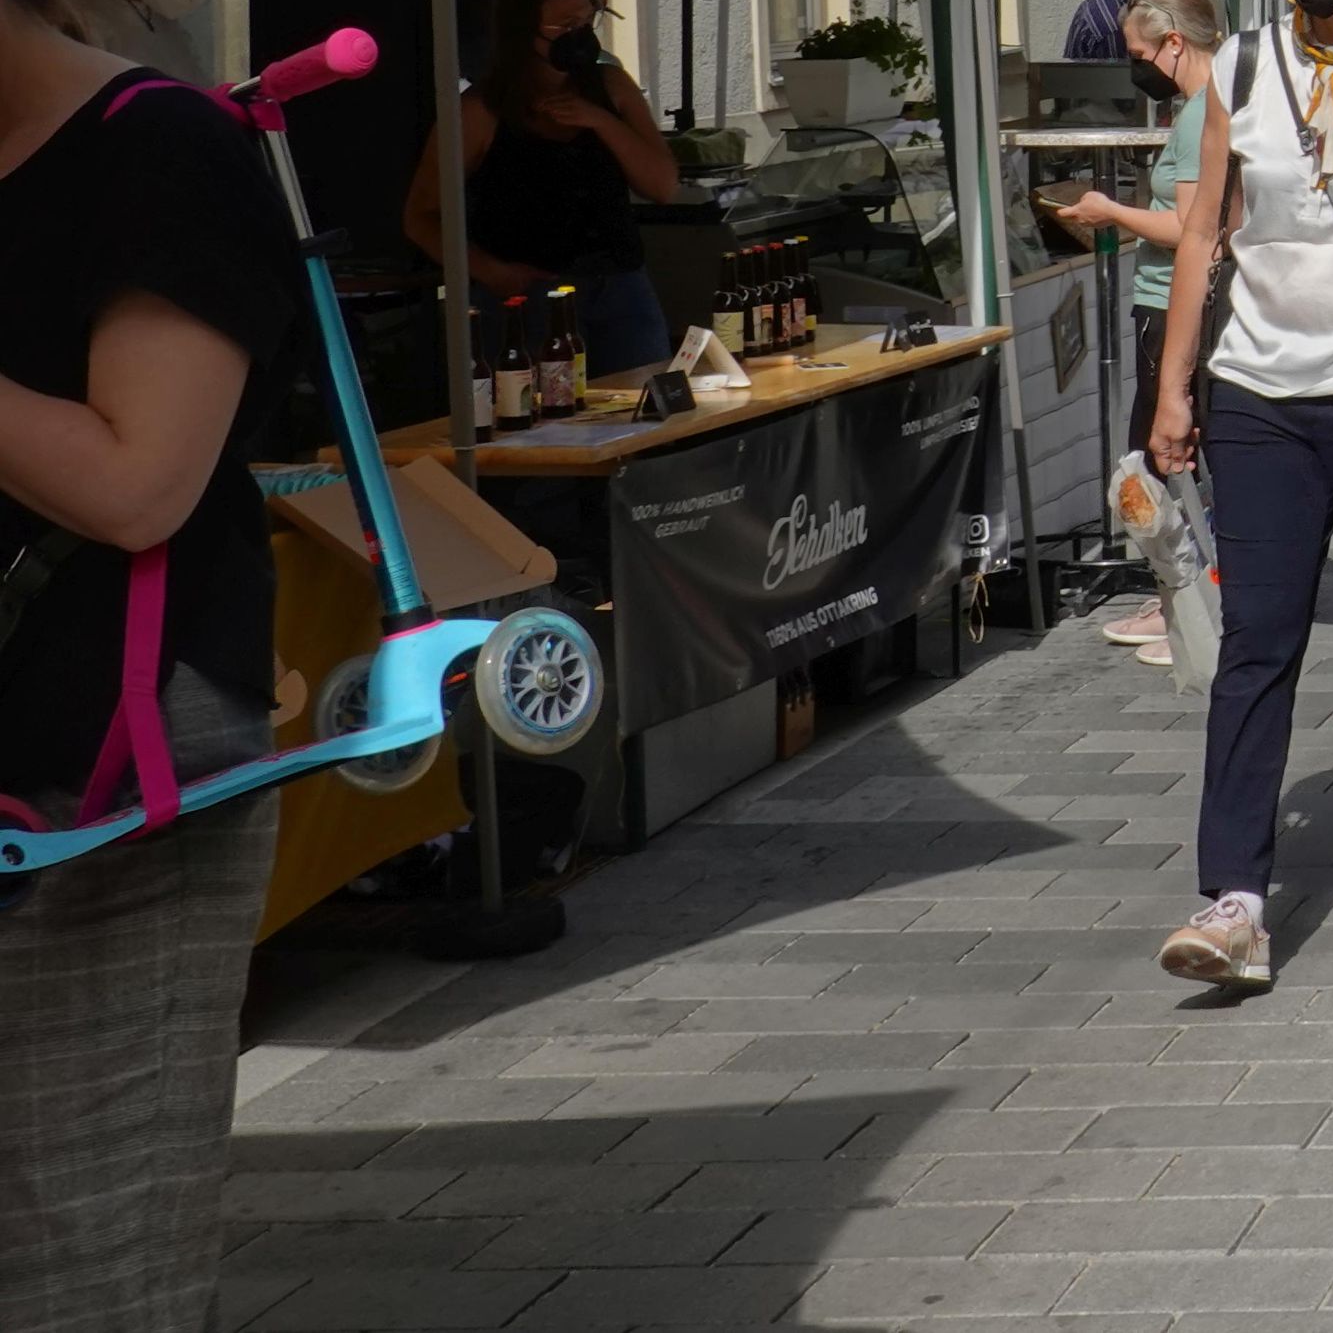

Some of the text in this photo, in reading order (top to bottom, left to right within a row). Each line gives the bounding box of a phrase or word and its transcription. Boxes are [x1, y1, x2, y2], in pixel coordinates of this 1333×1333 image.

[654, 515, 711, 539] GEBRAUT
[762, 493, 869, 591] Schalken
[797, 611, 819, 635] AUS
[817, 585, 879, 626] OTTAKRING
